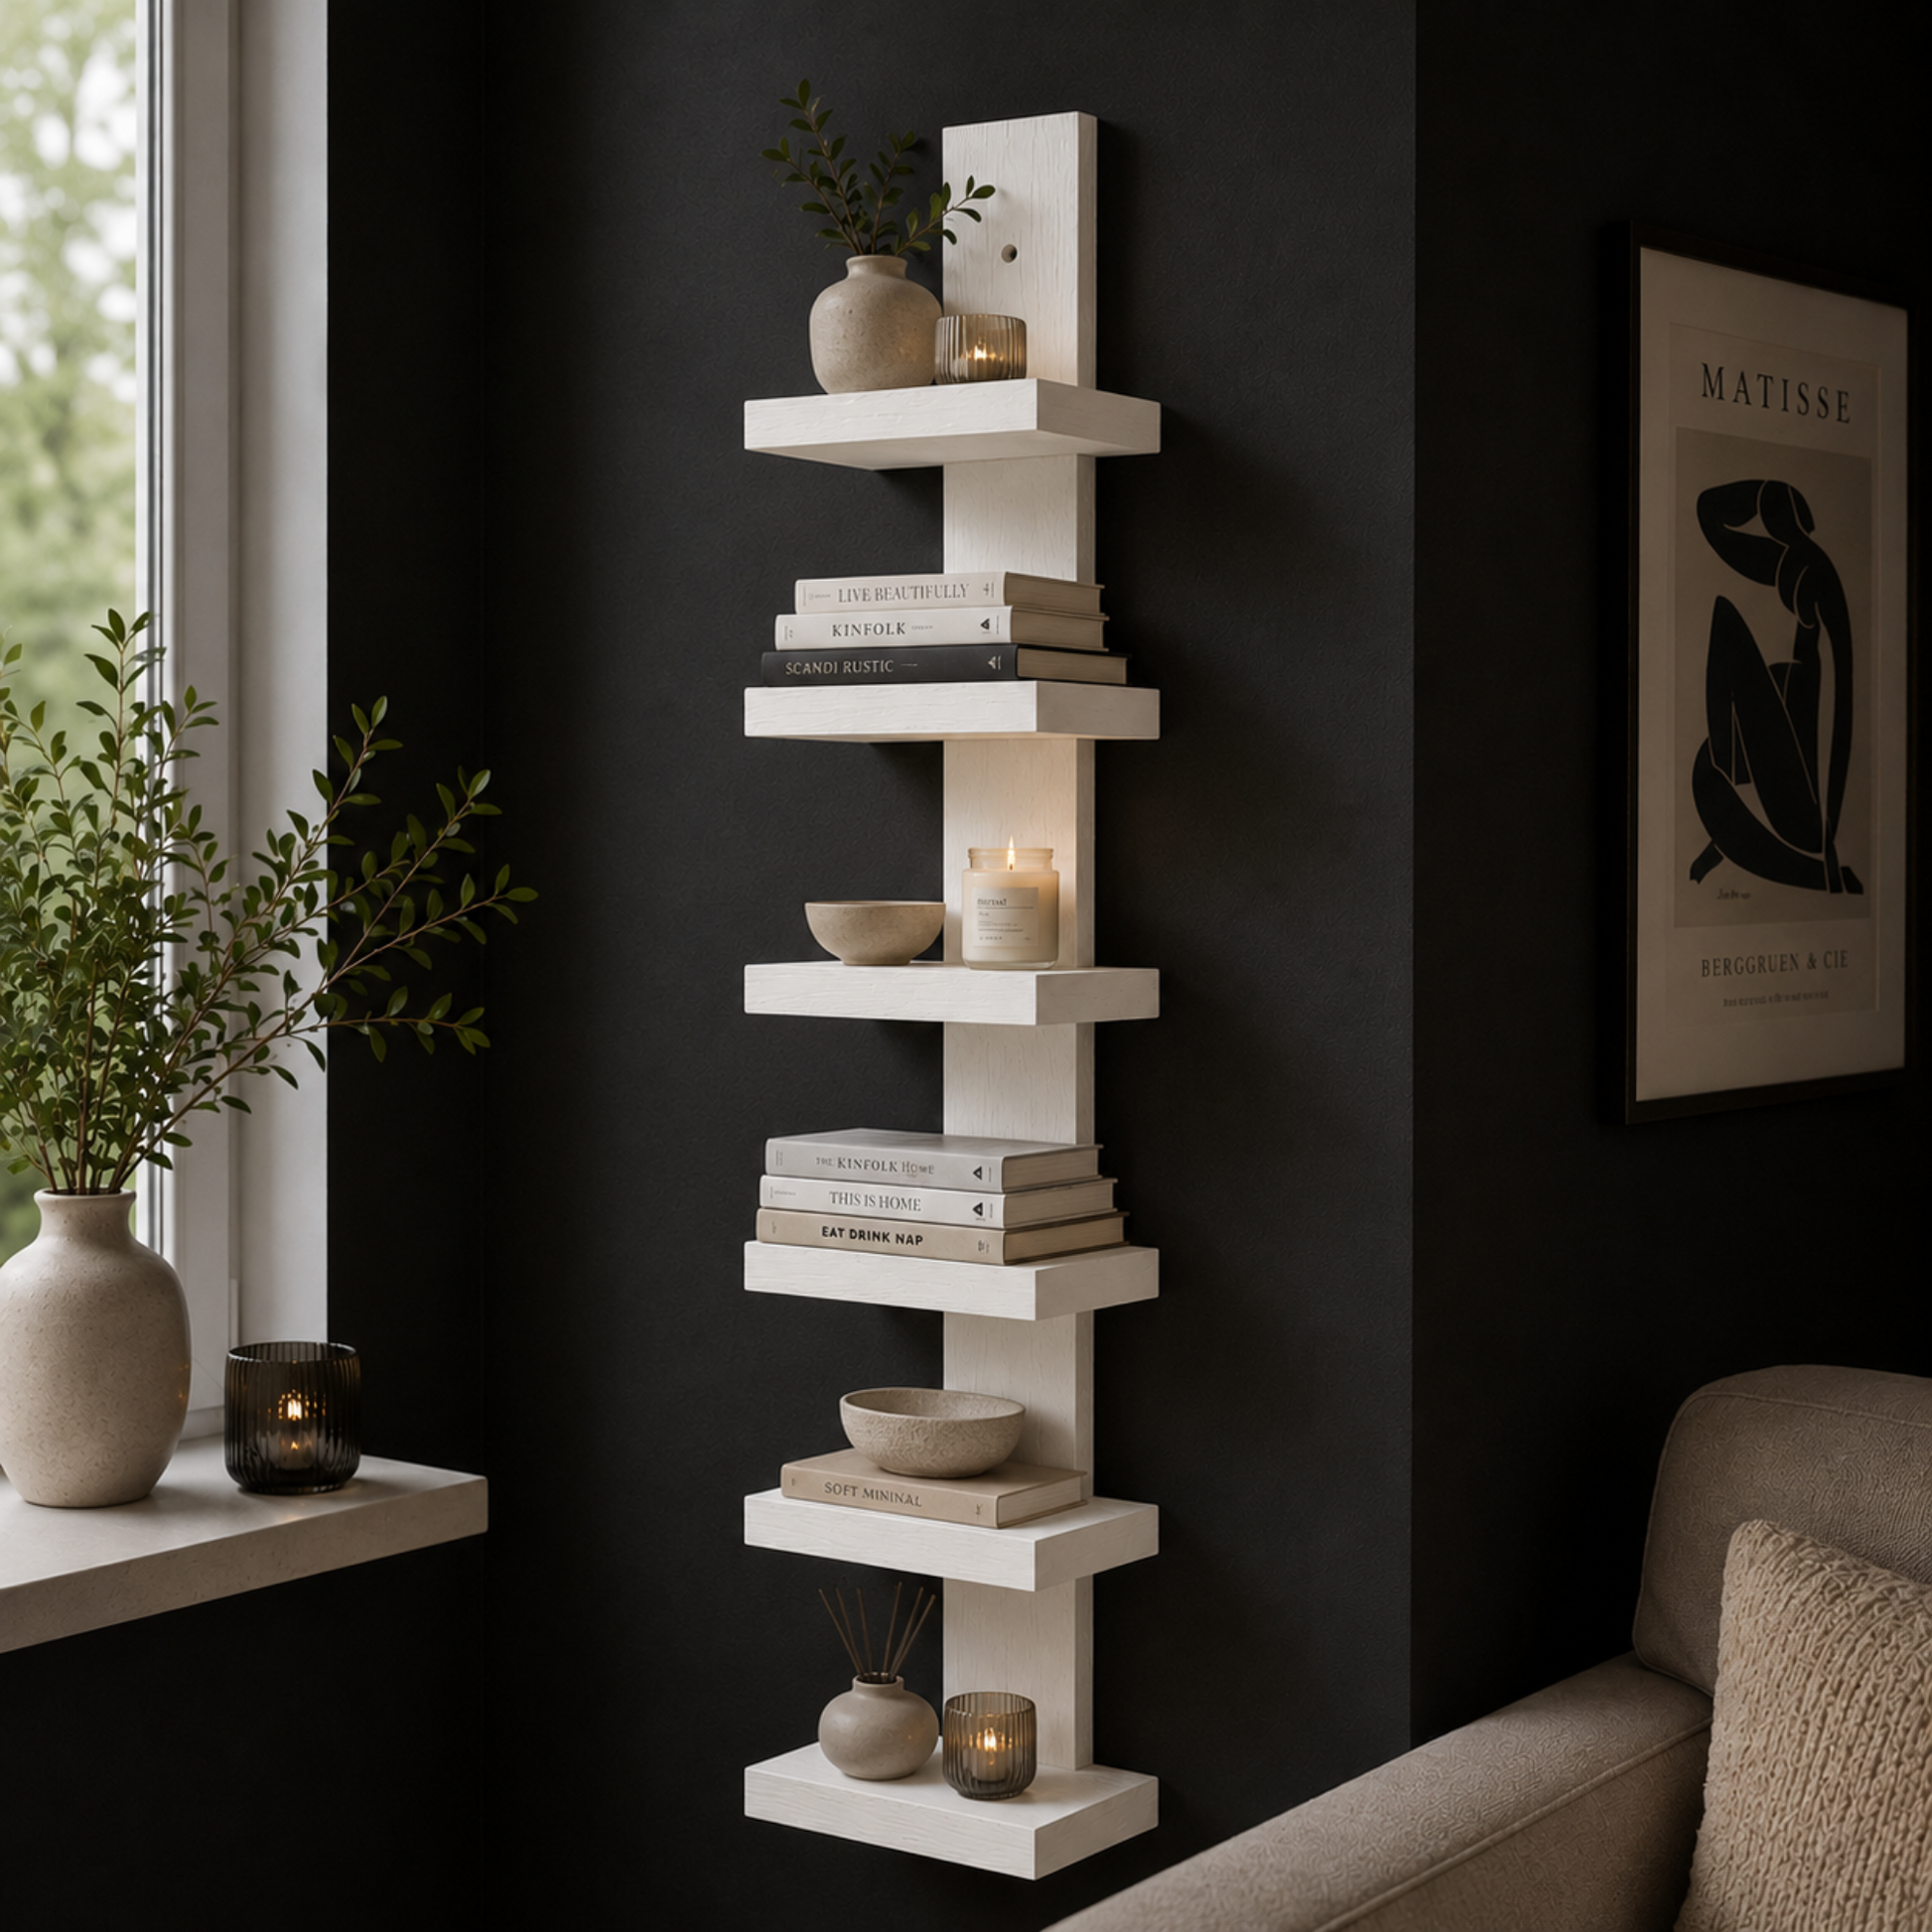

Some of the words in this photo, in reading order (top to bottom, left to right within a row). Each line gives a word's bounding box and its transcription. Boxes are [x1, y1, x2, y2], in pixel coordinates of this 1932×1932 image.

[1701, 362, 1851, 424] MATISSE
[838, 587, 872, 603] LIVE
[875, 583, 970, 602] BEAUTIFULLY
[832, 621, 906, 637] KINFOLK
[785, 661, 839, 676] SCANDI
[842, 659, 895, 674] RUSTIC
[1701, 953, 1799, 978] BERGGRUEN
[1806, 952, 1818, 970] &
[1823, 950, 1849, 969] CIE
[837, 1157, 898, 1173] KINFOLK
[829, 1190, 862, 1207] THIS
[863, 1193, 877, 1208] IS
[879, 1195, 921, 1211] HOME
[822, 1226, 846, 1239] EAT
[849, 1228, 892, 1244] DRINK
[895, 1232, 923, 1247] NAP
[824, 1481, 859, 1496] SOFT
